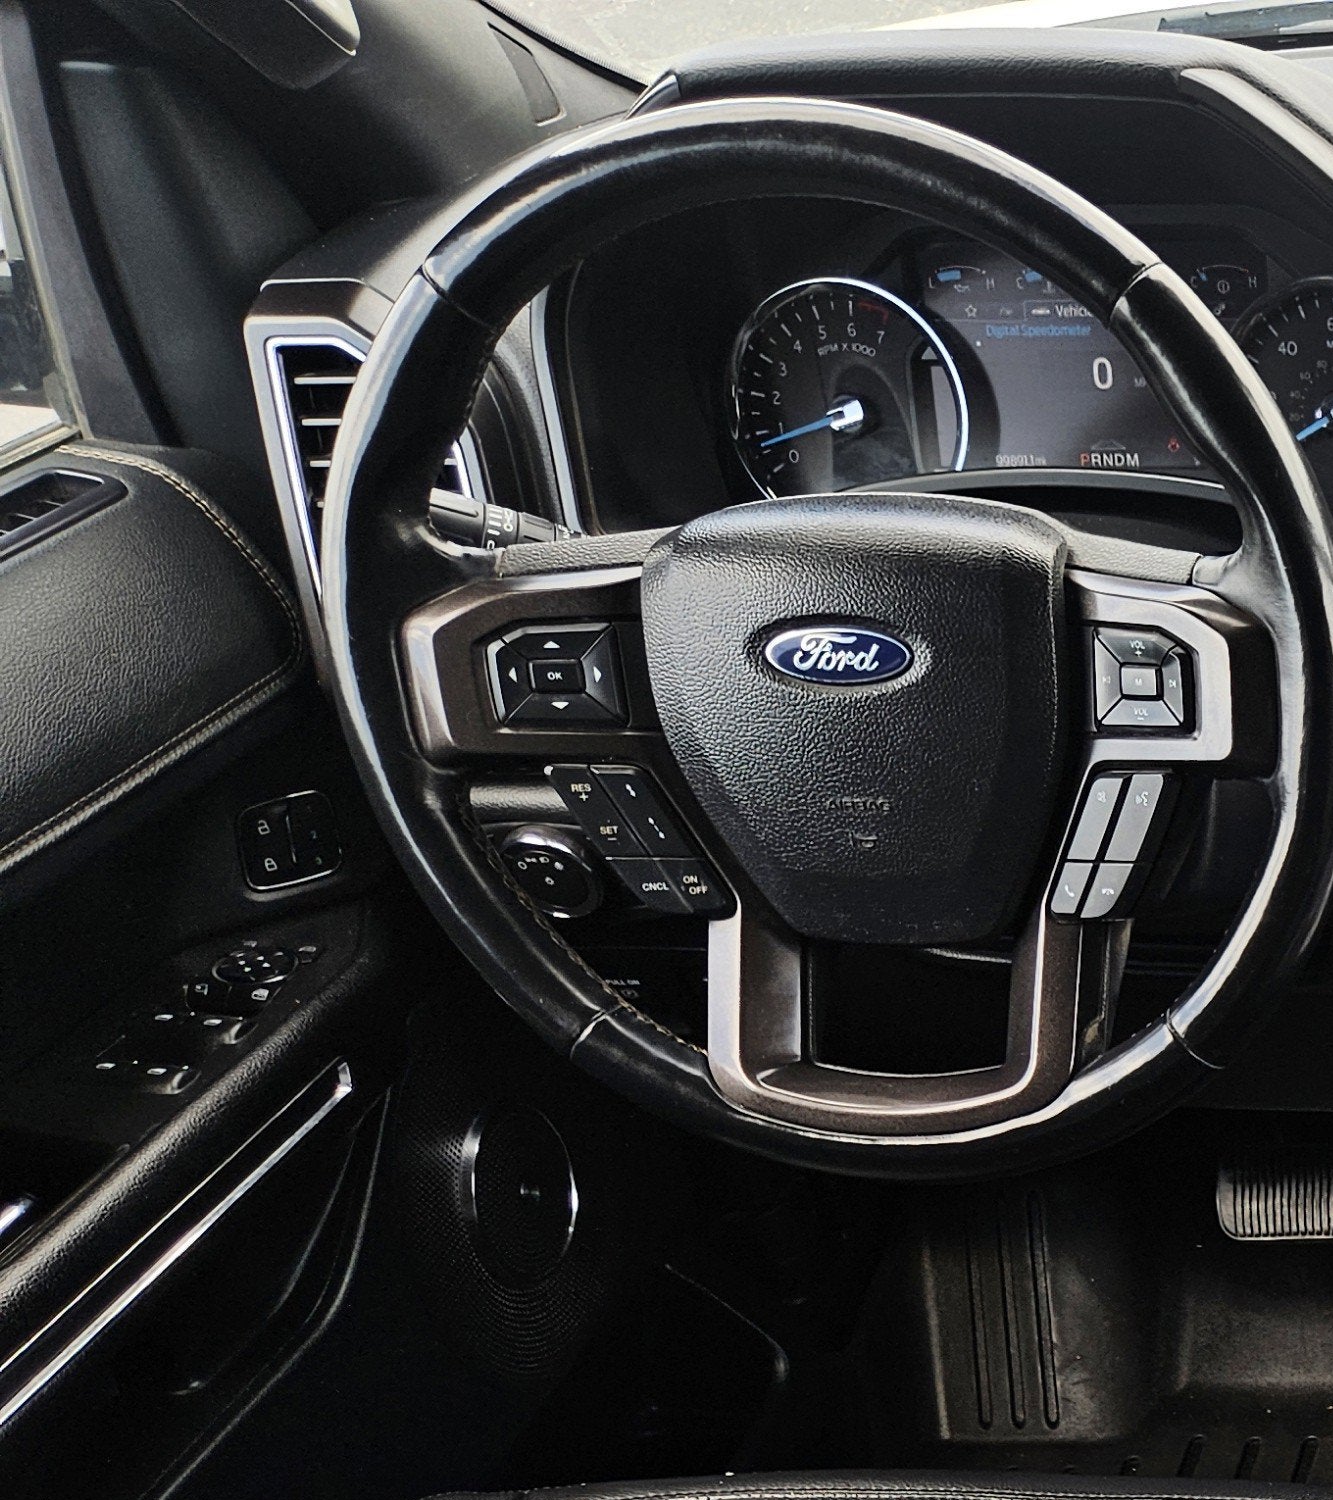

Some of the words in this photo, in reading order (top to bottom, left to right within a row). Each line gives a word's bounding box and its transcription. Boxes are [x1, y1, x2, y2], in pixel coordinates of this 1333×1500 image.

[818, 325, 827, 340] 5
[847, 323, 857, 338] 6
[877, 331, 885, 344] 7
[985, 324, 1020, 338] Digital
[1022, 324, 1092, 338] Speedometer
[793, 340, 802, 354] 4
[1277, 340, 1298, 356] 40
[779, 361, 788, 377] 3
[1092, 356, 1113, 390] 0
[772, 391, 782, 405] 2
[788, 449, 800, 464] 0
[1129, 639, 1146, 650] VOL
[793, 632, 880, 673] Ford
[547, 671, 563, 681] OK
[1134, 707, 1149, 717] VOL
[570, 783, 592, 793] RES
[599, 825, 619, 836] SET
[641, 881, 670, 892] CNCL
[682, 875, 698, 885] ON
[688, 885, 708, 895] OFF
